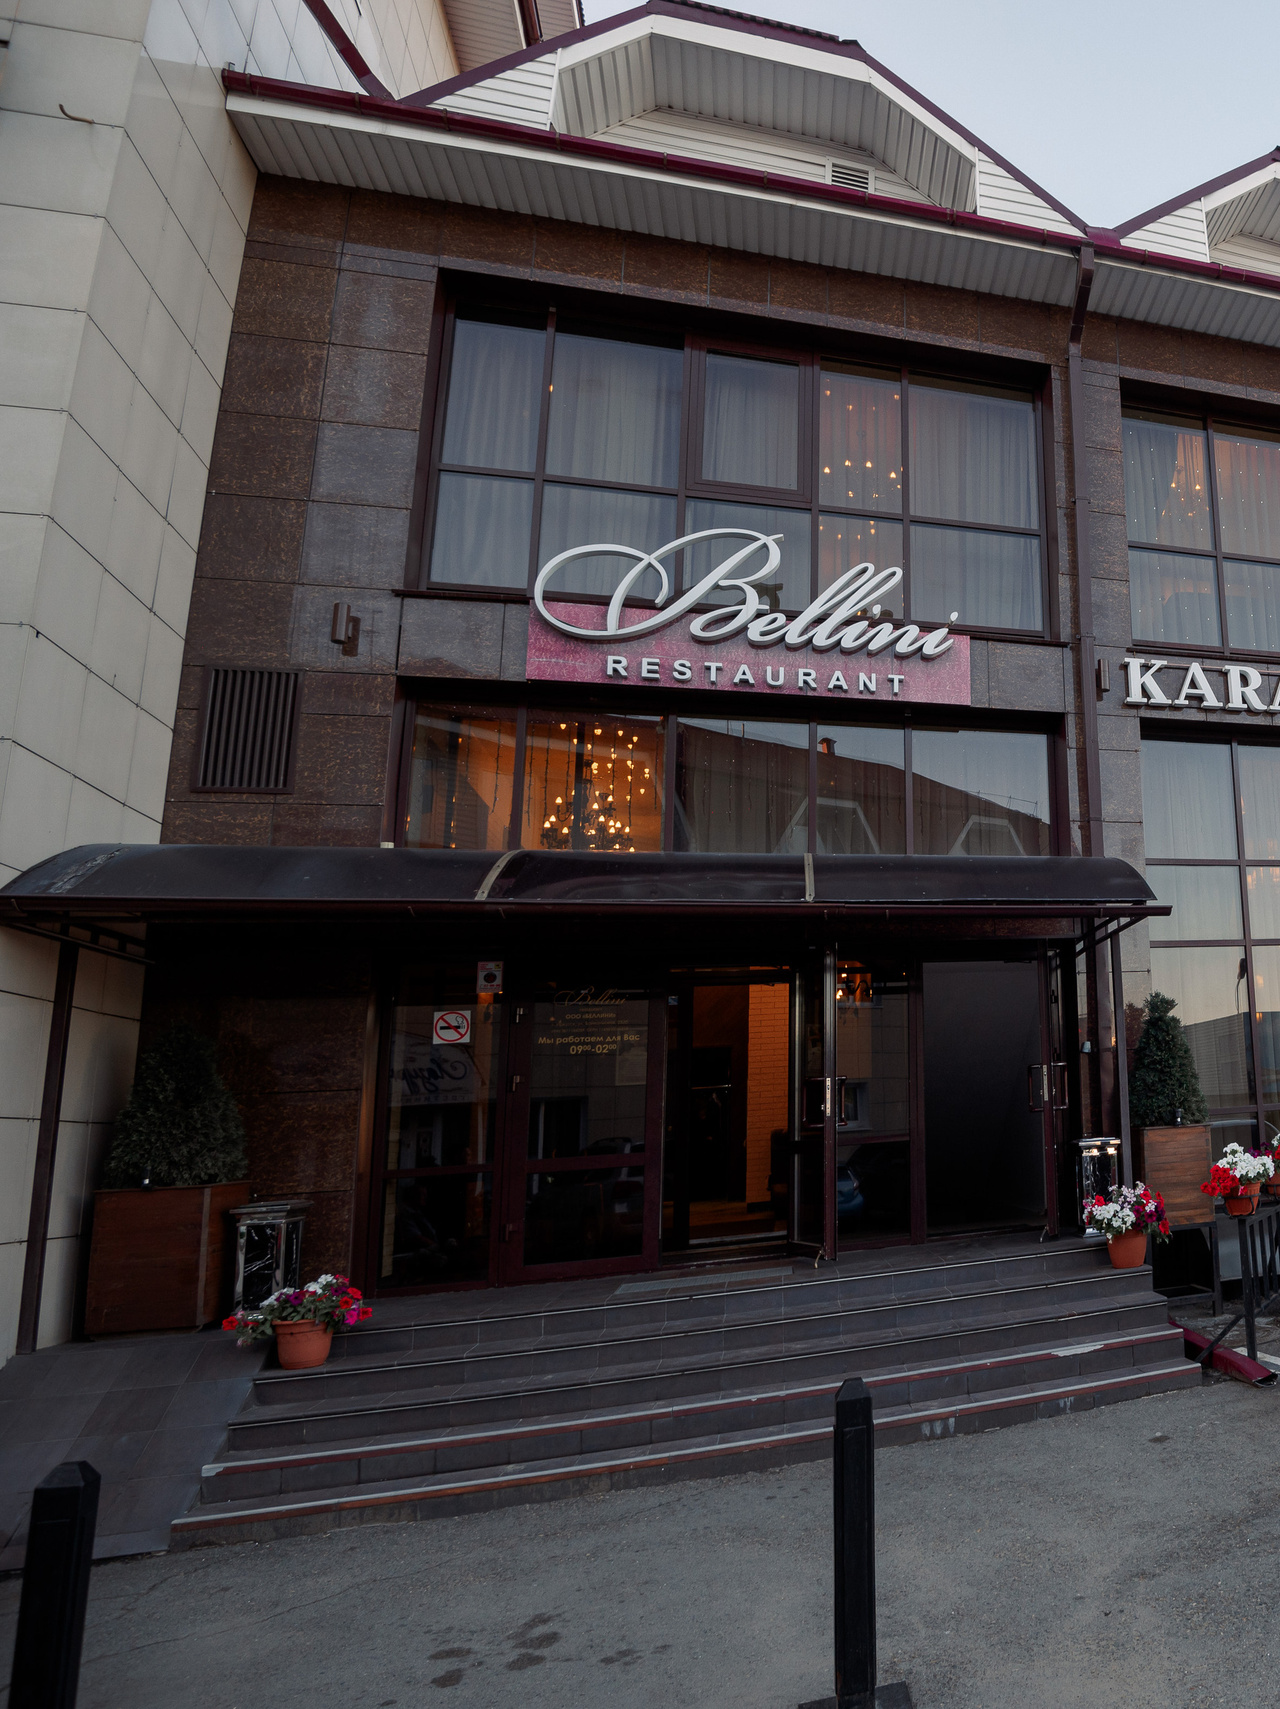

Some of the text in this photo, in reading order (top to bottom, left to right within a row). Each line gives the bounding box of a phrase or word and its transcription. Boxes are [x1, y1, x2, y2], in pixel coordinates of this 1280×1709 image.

[534, 528, 960, 660] Bellini
[606, 655, 906, 695] RESTAURANT
[538, 1036, 554, 1044] Мы
[555, 1035, 604, 1046] работаем
